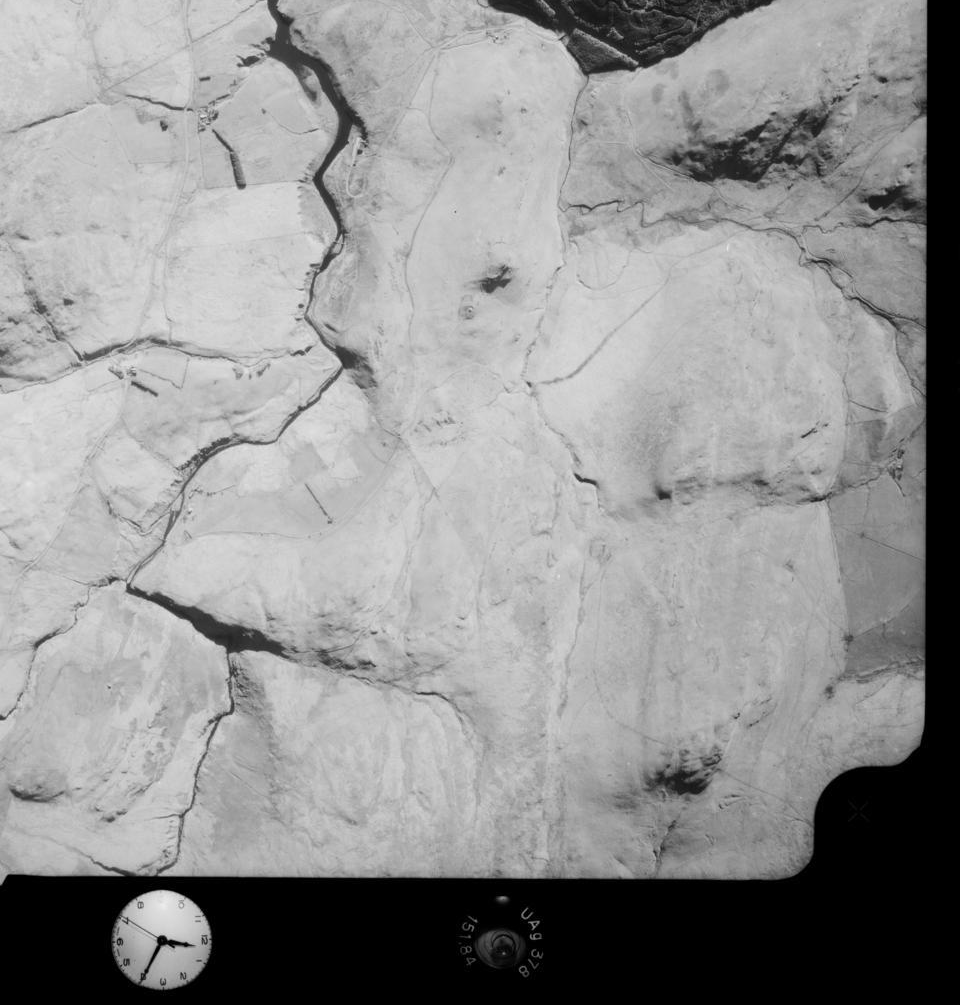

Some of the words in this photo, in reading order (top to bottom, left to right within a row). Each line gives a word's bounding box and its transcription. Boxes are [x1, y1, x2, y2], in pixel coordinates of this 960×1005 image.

[178, 899, 185, 909] 10
[116, 937, 124, 946] 6
[201, 934, 209, 946] 12
[123, 958, 130, 967] 5
[518, 949, 544, 978] 378
[180, 972, 187, 980] 2
[159, 978, 167, 986] 3
